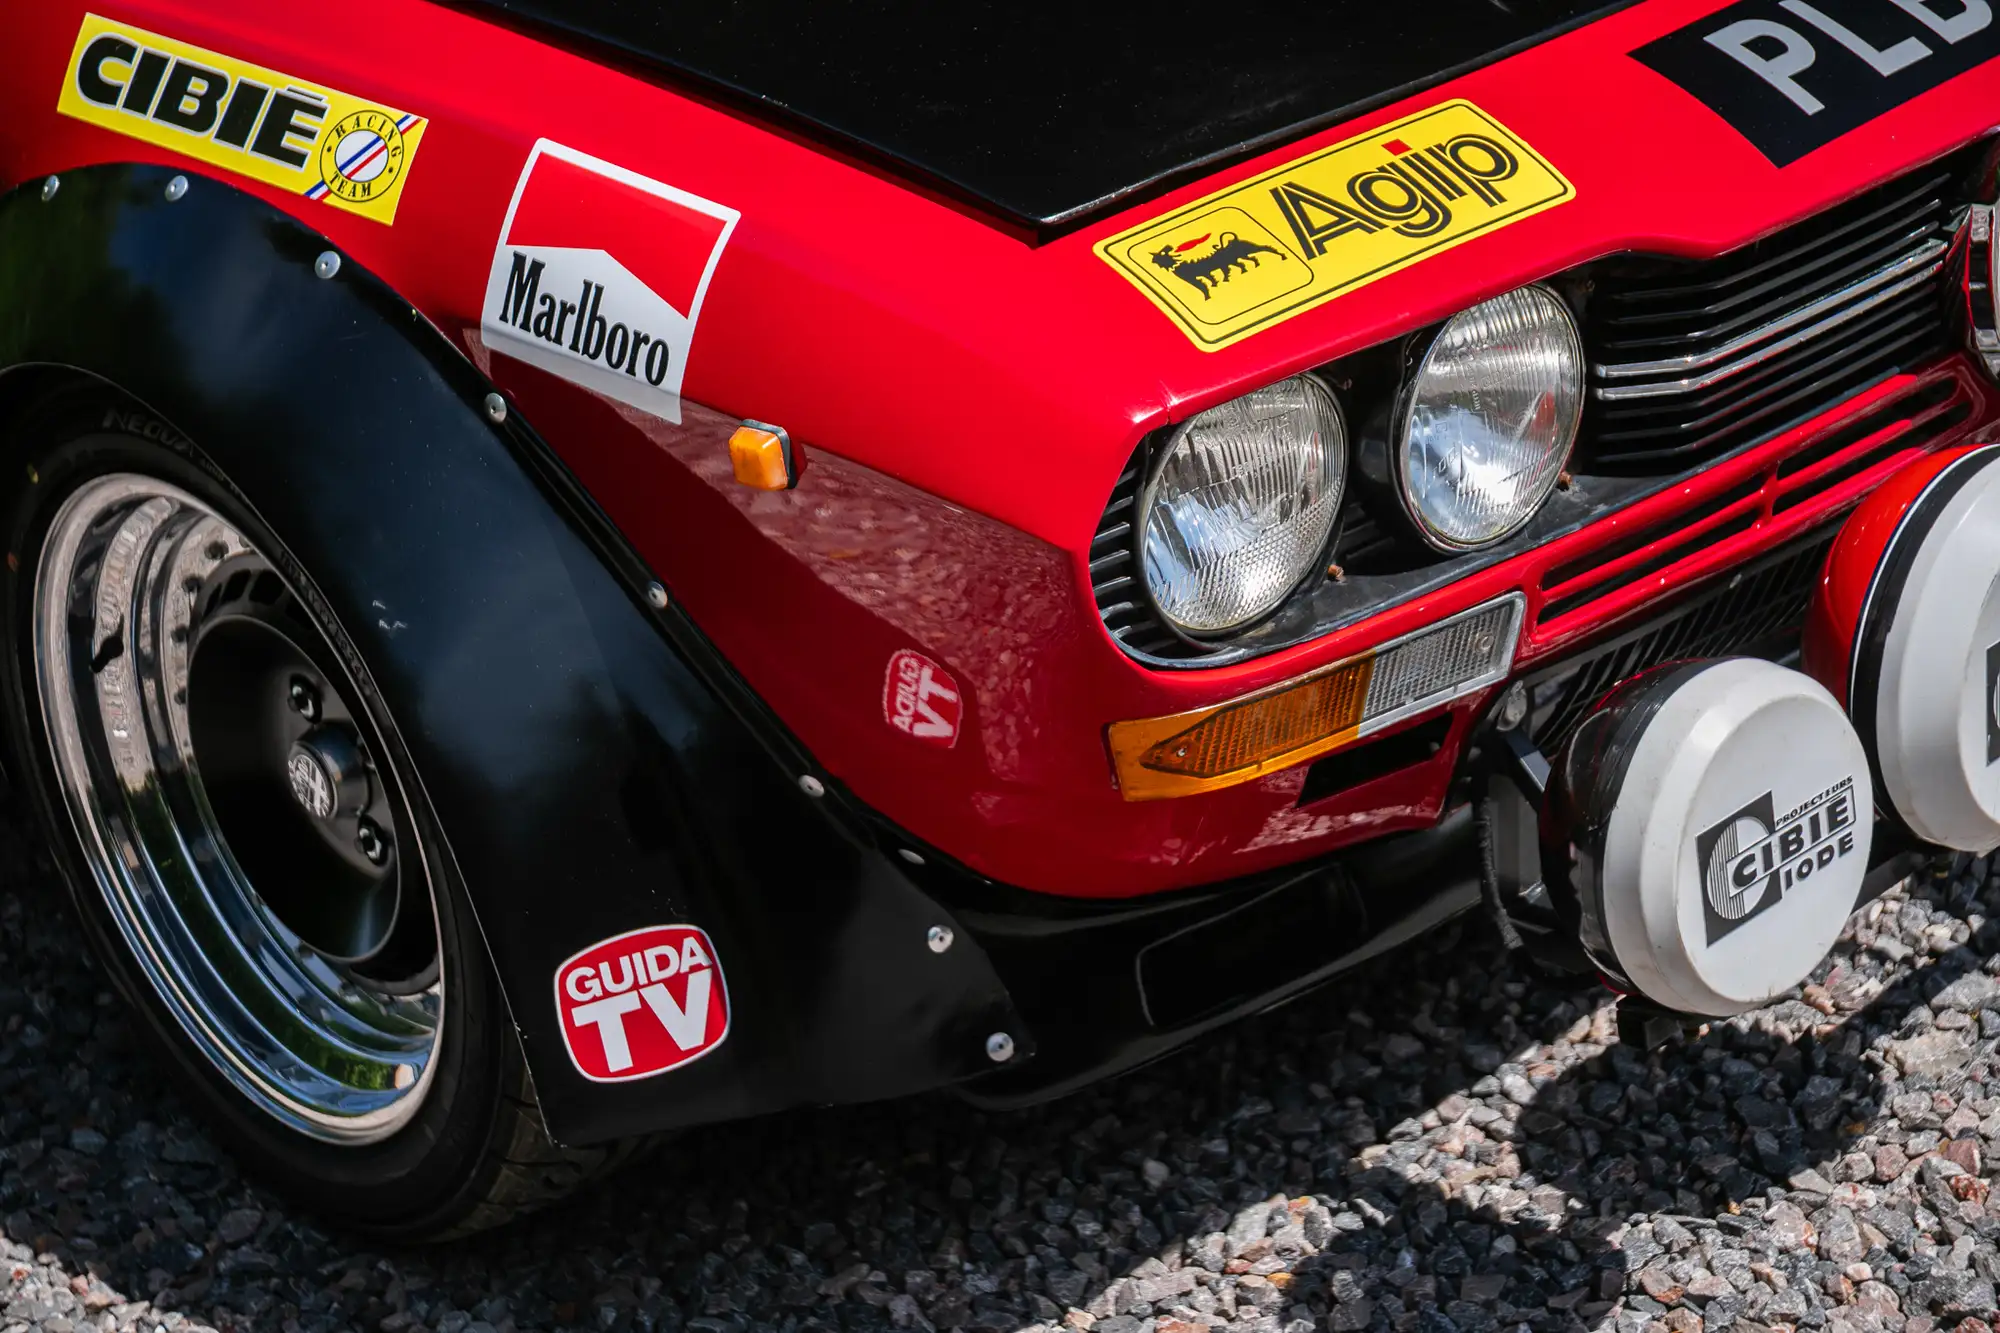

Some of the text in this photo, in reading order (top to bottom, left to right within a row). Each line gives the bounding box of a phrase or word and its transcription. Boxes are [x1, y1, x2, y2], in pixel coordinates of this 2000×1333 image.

[334, 114, 402, 159] RACING
[329, 171, 372, 198] TEAM
[1269, 133, 1519, 261] Agip
[498, 250, 670, 387] Marlboro
[1775, 775, 1854, 827] PROJECTEURS
[1784, 831, 1854, 892] IODE
[565, 936, 713, 1003] GUIDA
[571, 968, 713, 1073] TV
